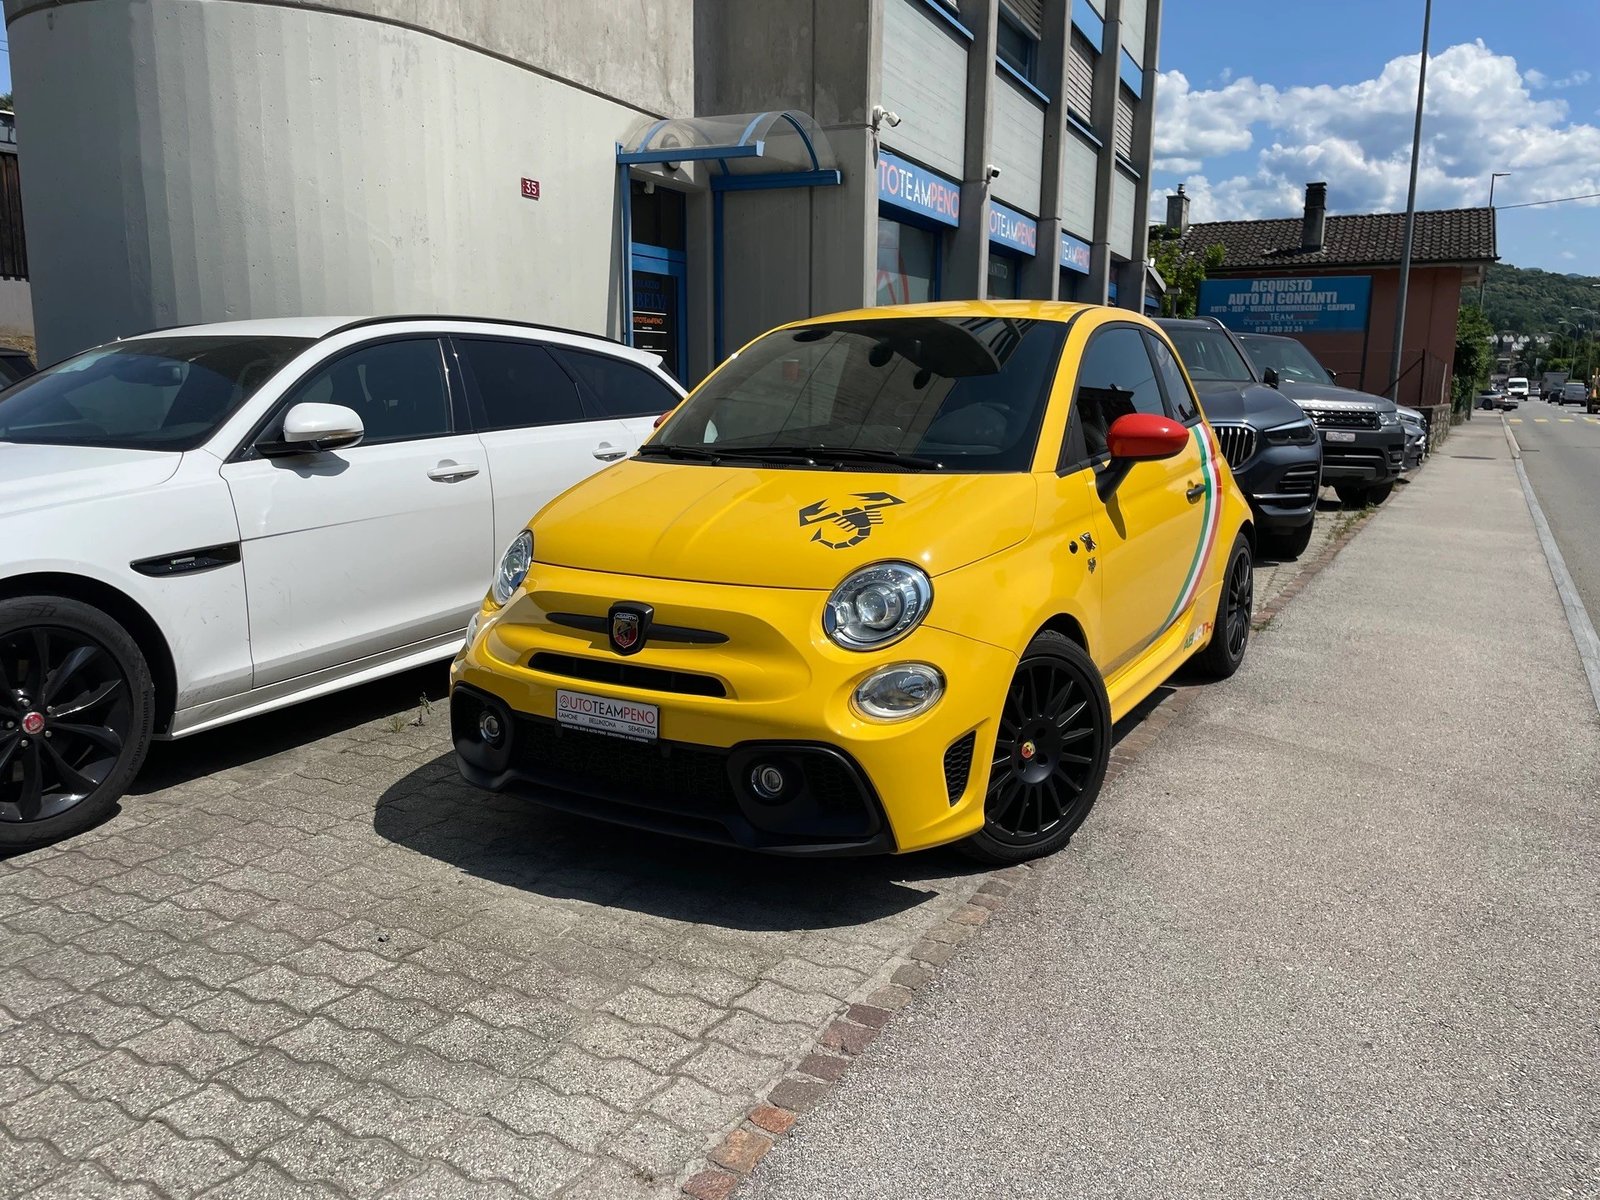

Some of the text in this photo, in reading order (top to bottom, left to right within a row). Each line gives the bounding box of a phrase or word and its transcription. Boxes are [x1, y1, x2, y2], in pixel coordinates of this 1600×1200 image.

[525, 180, 537, 194] 35
[880, 160, 960, 218] TOTEAMPENO
[989, 209, 1037, 250] OTEAMPENO
[1062, 240, 1091, 269] TEAMPENO
[1251, 279, 1312, 293] ACQUISTO
[1228, 291, 1338, 305] AUTO IN CONTANTI
[628, 725, 656, 736] SEMENTINA
